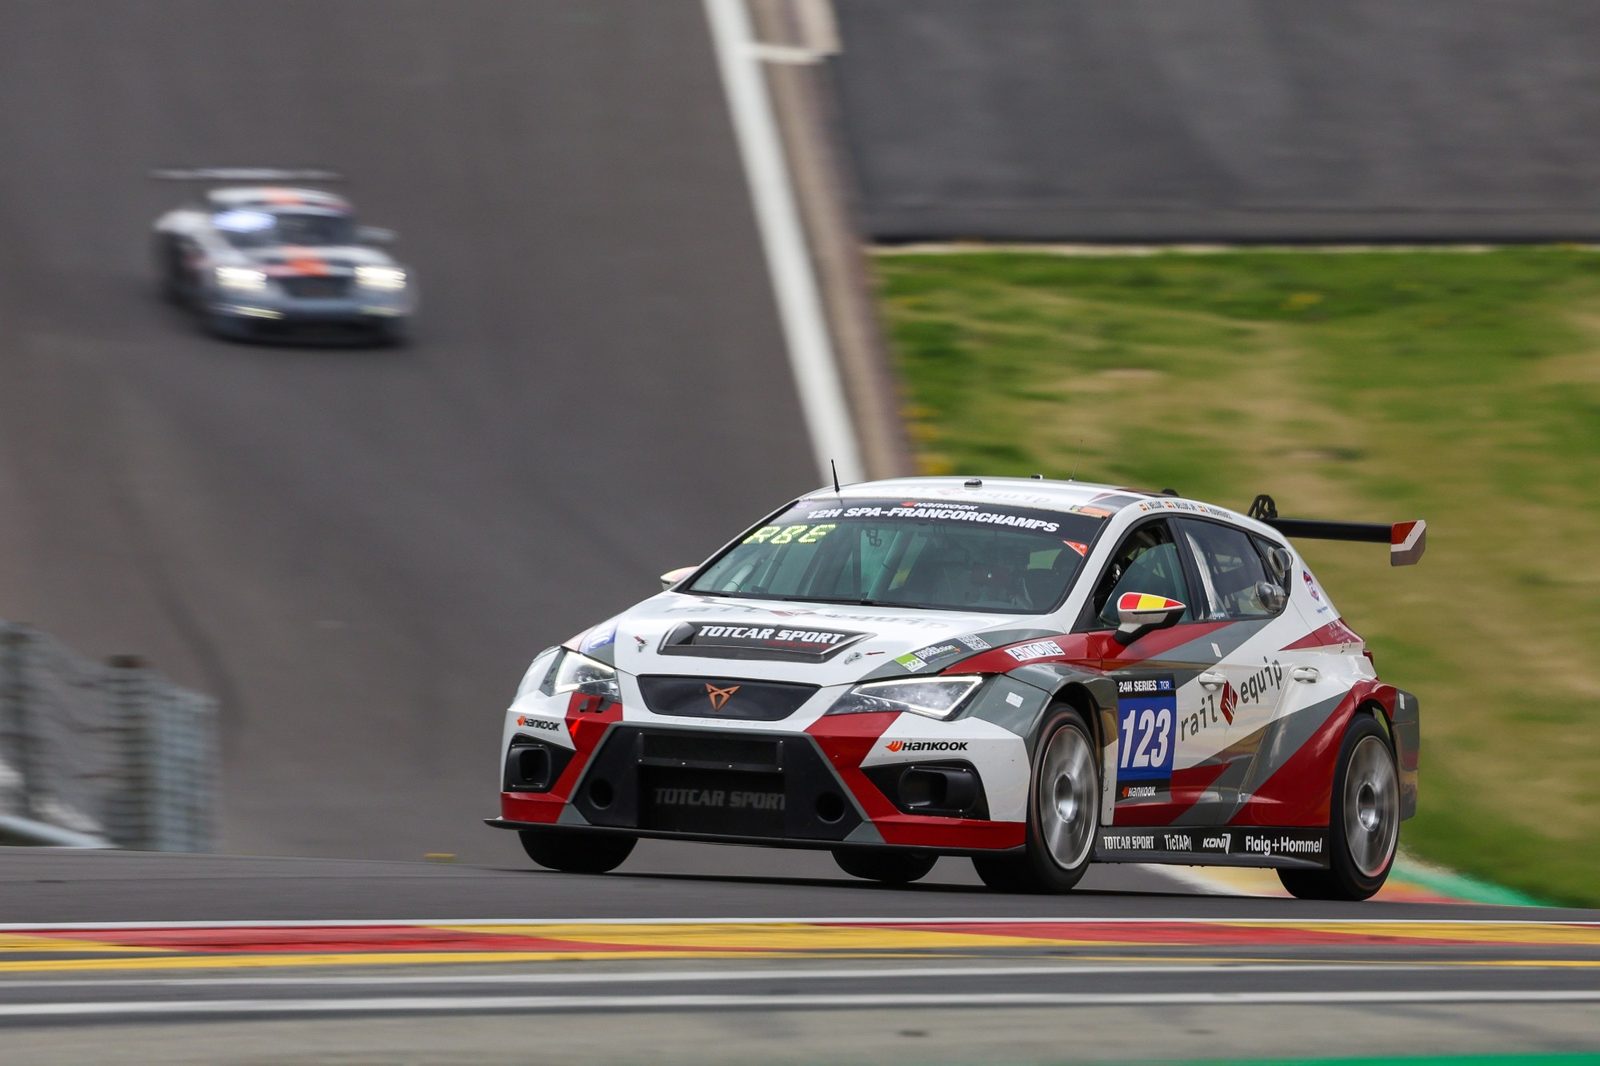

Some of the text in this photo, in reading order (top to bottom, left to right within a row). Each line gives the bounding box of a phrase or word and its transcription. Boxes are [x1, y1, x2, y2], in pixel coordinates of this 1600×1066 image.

[807, 507, 1060, 533] 12H SPA-FRANCORCHAMPS
[698, 625, 774, 641] TOTCAR
[775, 629, 846, 645] SPORT
[1118, 680, 1170, 693] 24H SERIES TCR
[1181, 655, 1283, 742] rail equip
[901, 741, 968, 751] HANKOOK
[1120, 708, 1172, 769] 123
[656, 788, 786, 811] TOTCAR SPORT
[1103, 836, 1155, 850] TOTCAR SPORT
[1245, 835, 1323, 856] Flaig+Hommel
